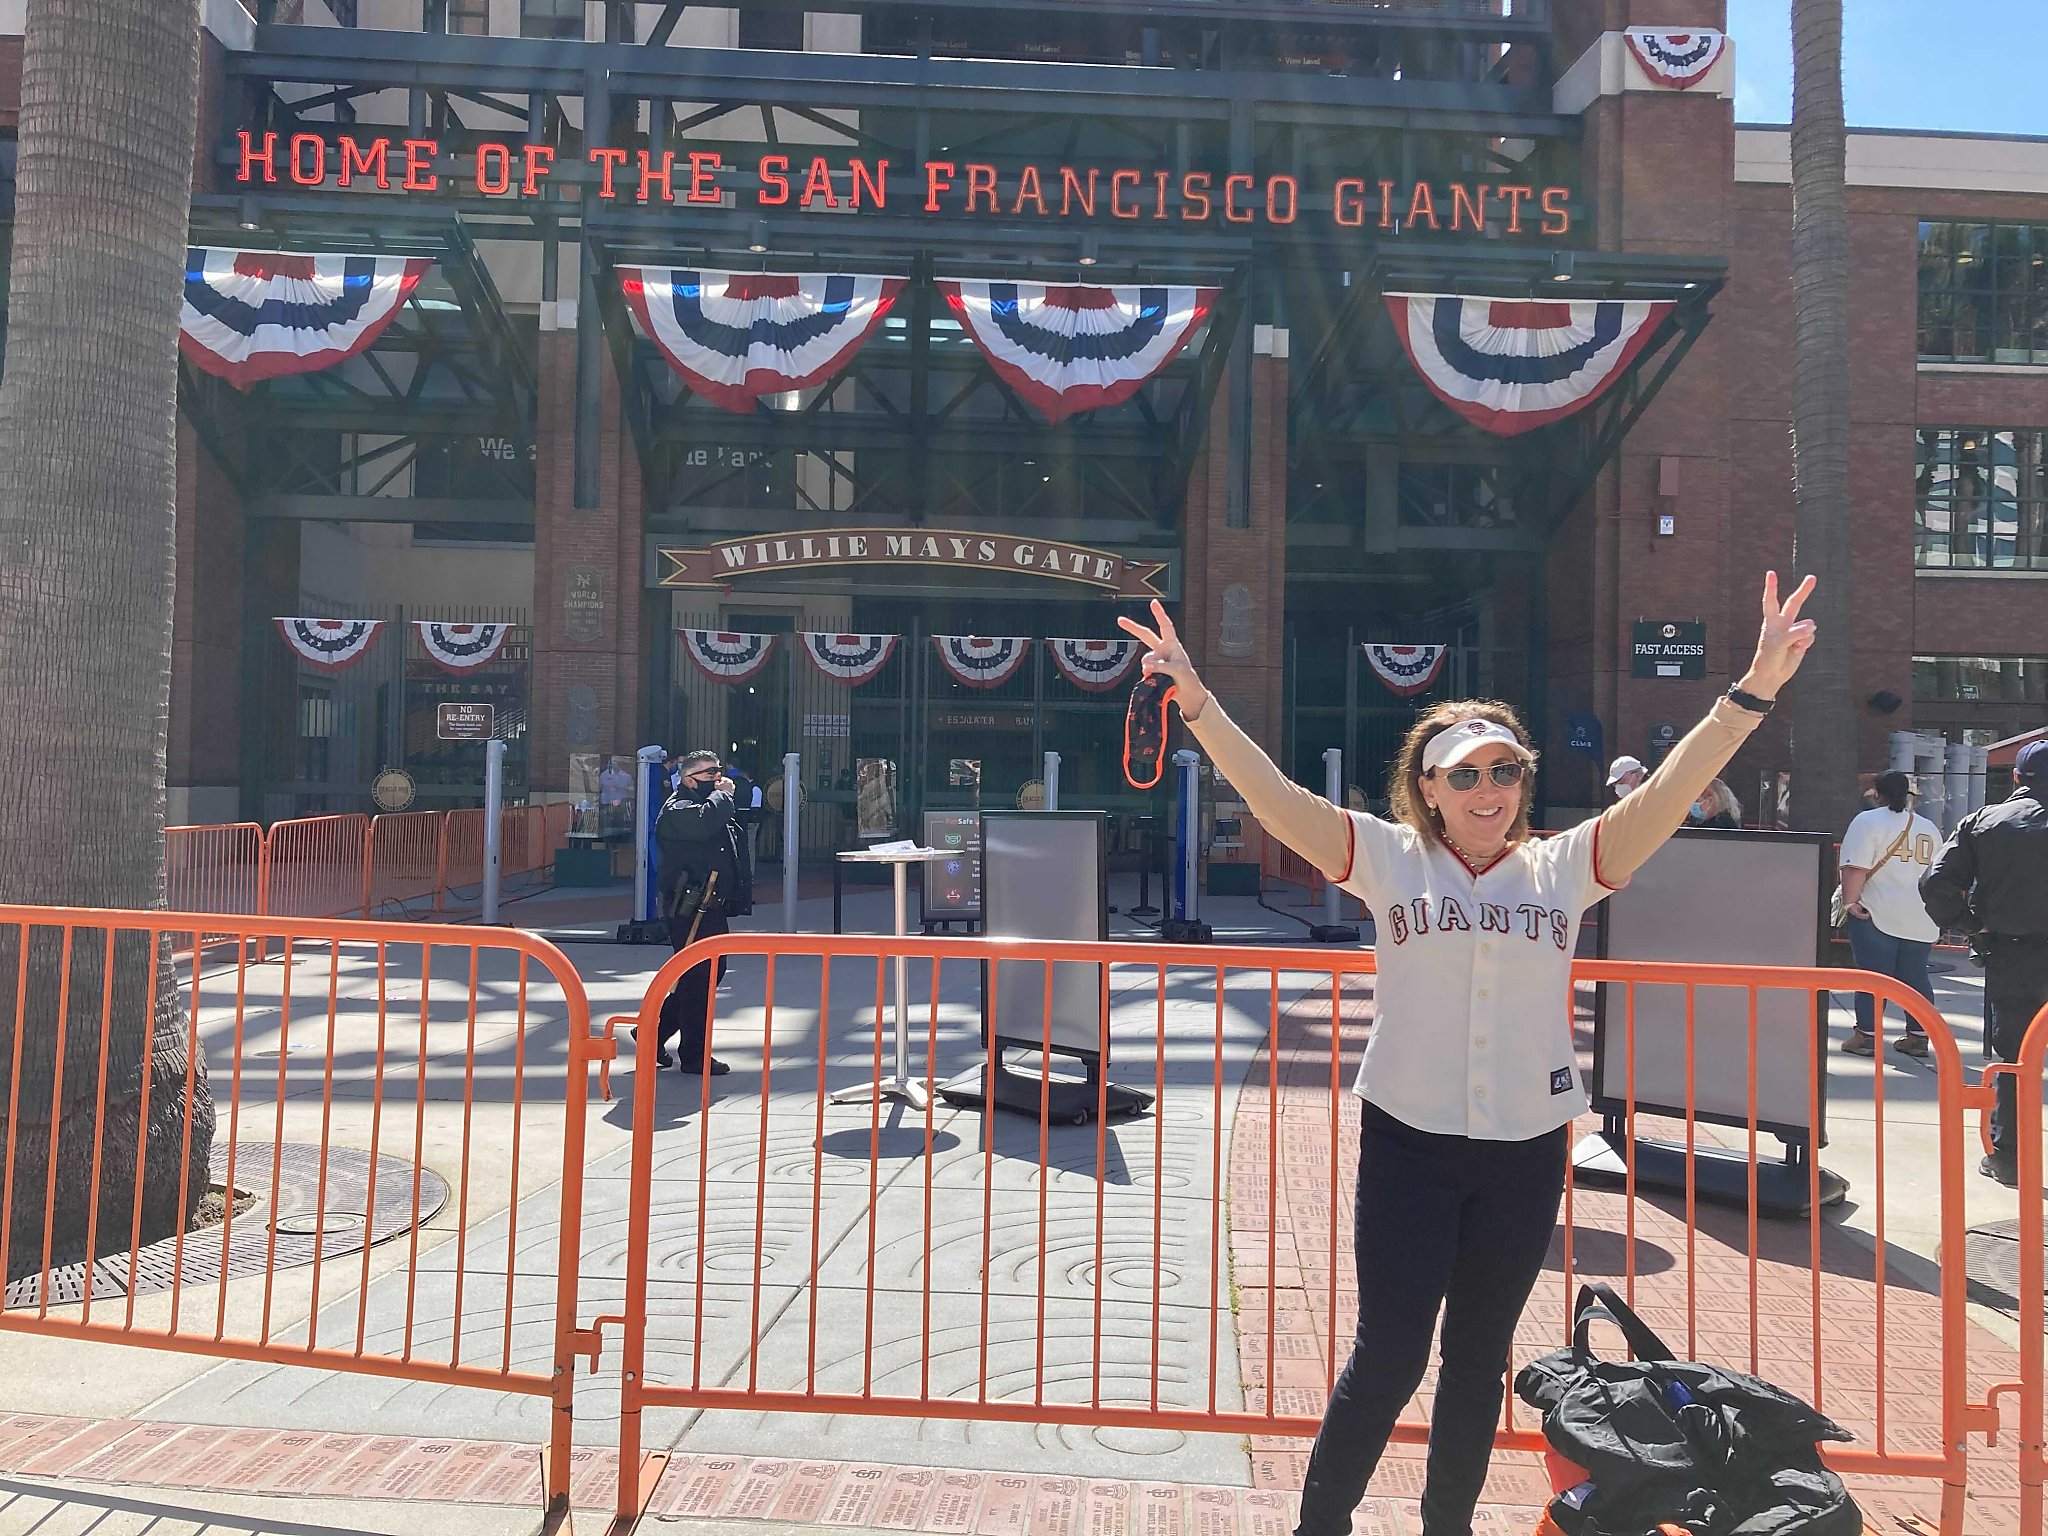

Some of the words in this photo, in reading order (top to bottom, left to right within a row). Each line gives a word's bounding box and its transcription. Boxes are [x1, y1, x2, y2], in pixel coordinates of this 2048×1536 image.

[237, 130, 439, 192] HOME
[476, 143, 555, 196] OF
[590, 147, 722, 204] THE
[758, 154, 889, 210] SAN
[925, 160, 1298, 225] FRANCISCO
[1333, 177, 1571, 237] GIANTS
[720, 535, 868, 568] WILLIE
[884, 535, 997, 562] MAYS
[1012, 544, 1115, 581] GATE
[571, 590, 598, 600] WORLD
[563, 600, 605, 609] CHAMPIONS
[1635, 643, 1662, 655] FAST
[1662, 644, 1704, 656] ACCESS
[460, 705, 473, 714] NO
[446, 713, 486, 722] RE-ENTRY
[1886, 830, 1934, 865] 40
[1389, 896, 1568, 951] GIANTS
